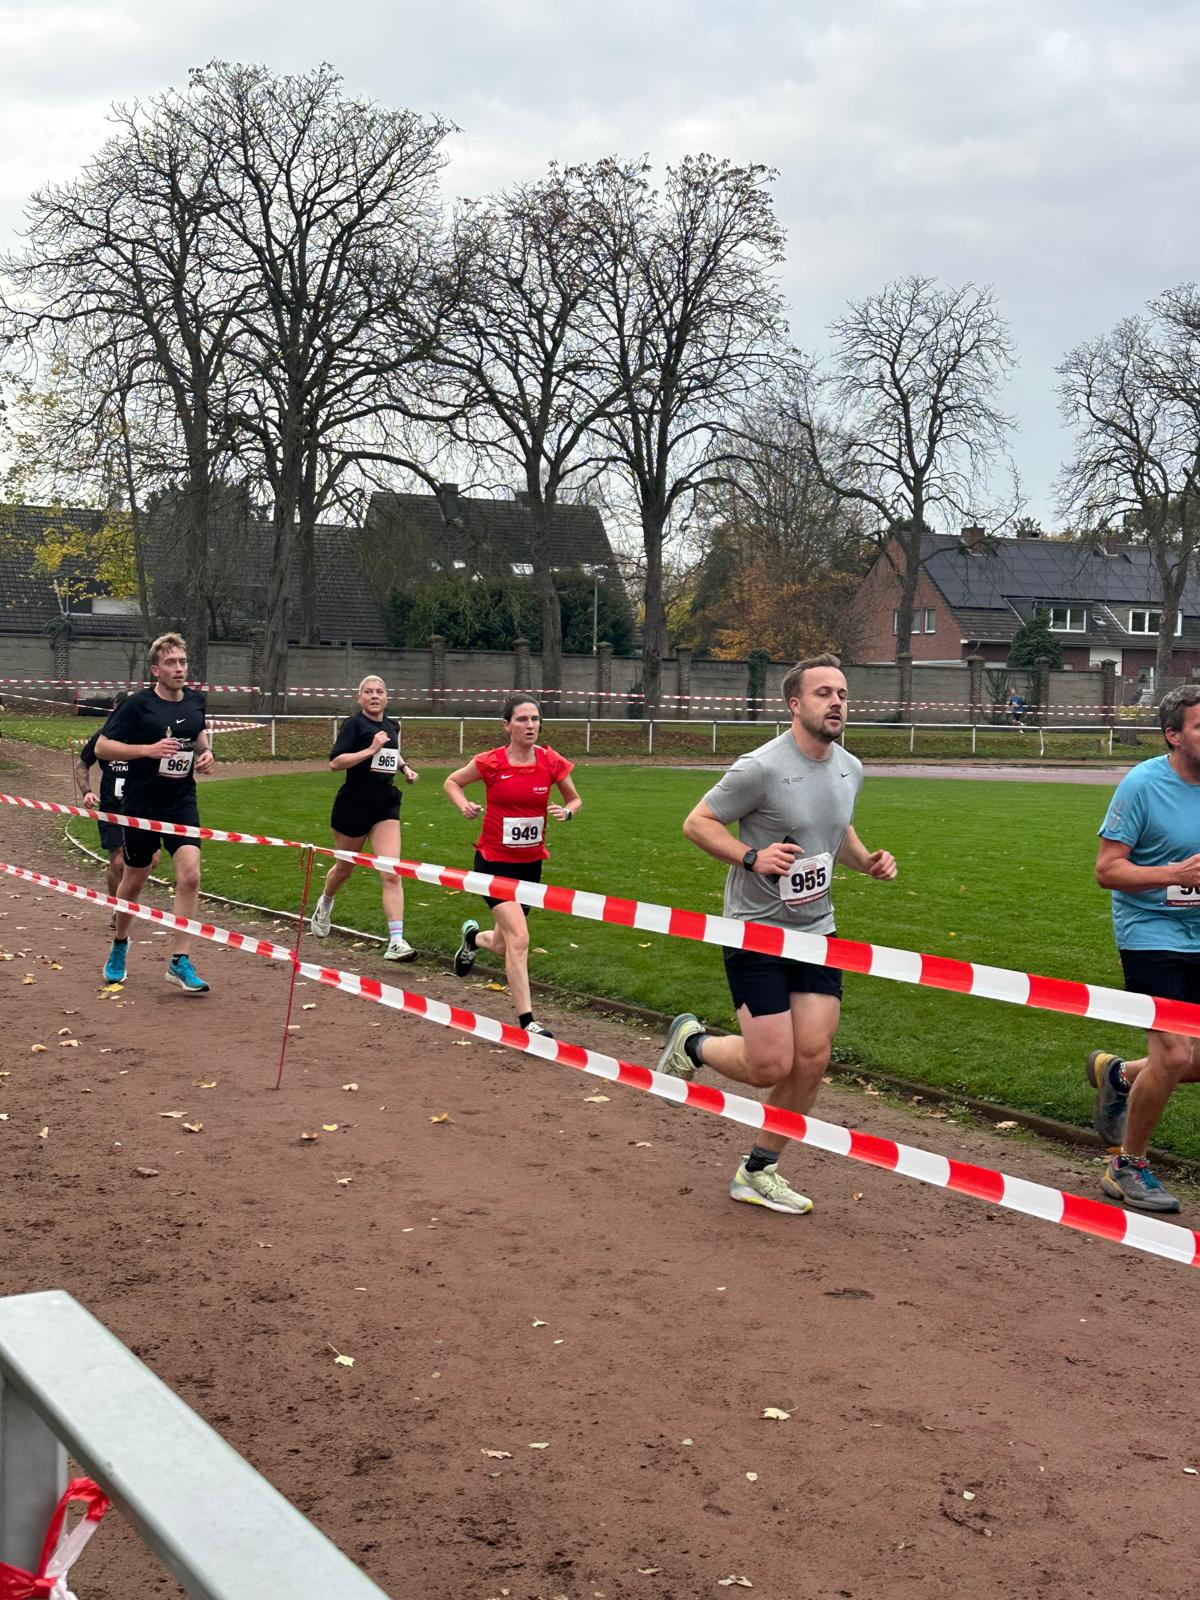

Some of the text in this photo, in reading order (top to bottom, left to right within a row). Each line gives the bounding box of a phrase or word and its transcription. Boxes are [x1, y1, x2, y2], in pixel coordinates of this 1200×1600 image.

[167, 759, 189, 771] 962
[378, 756, 395, 767] 965
[512, 826, 538, 840] 949
[791, 867, 826, 893] 955
